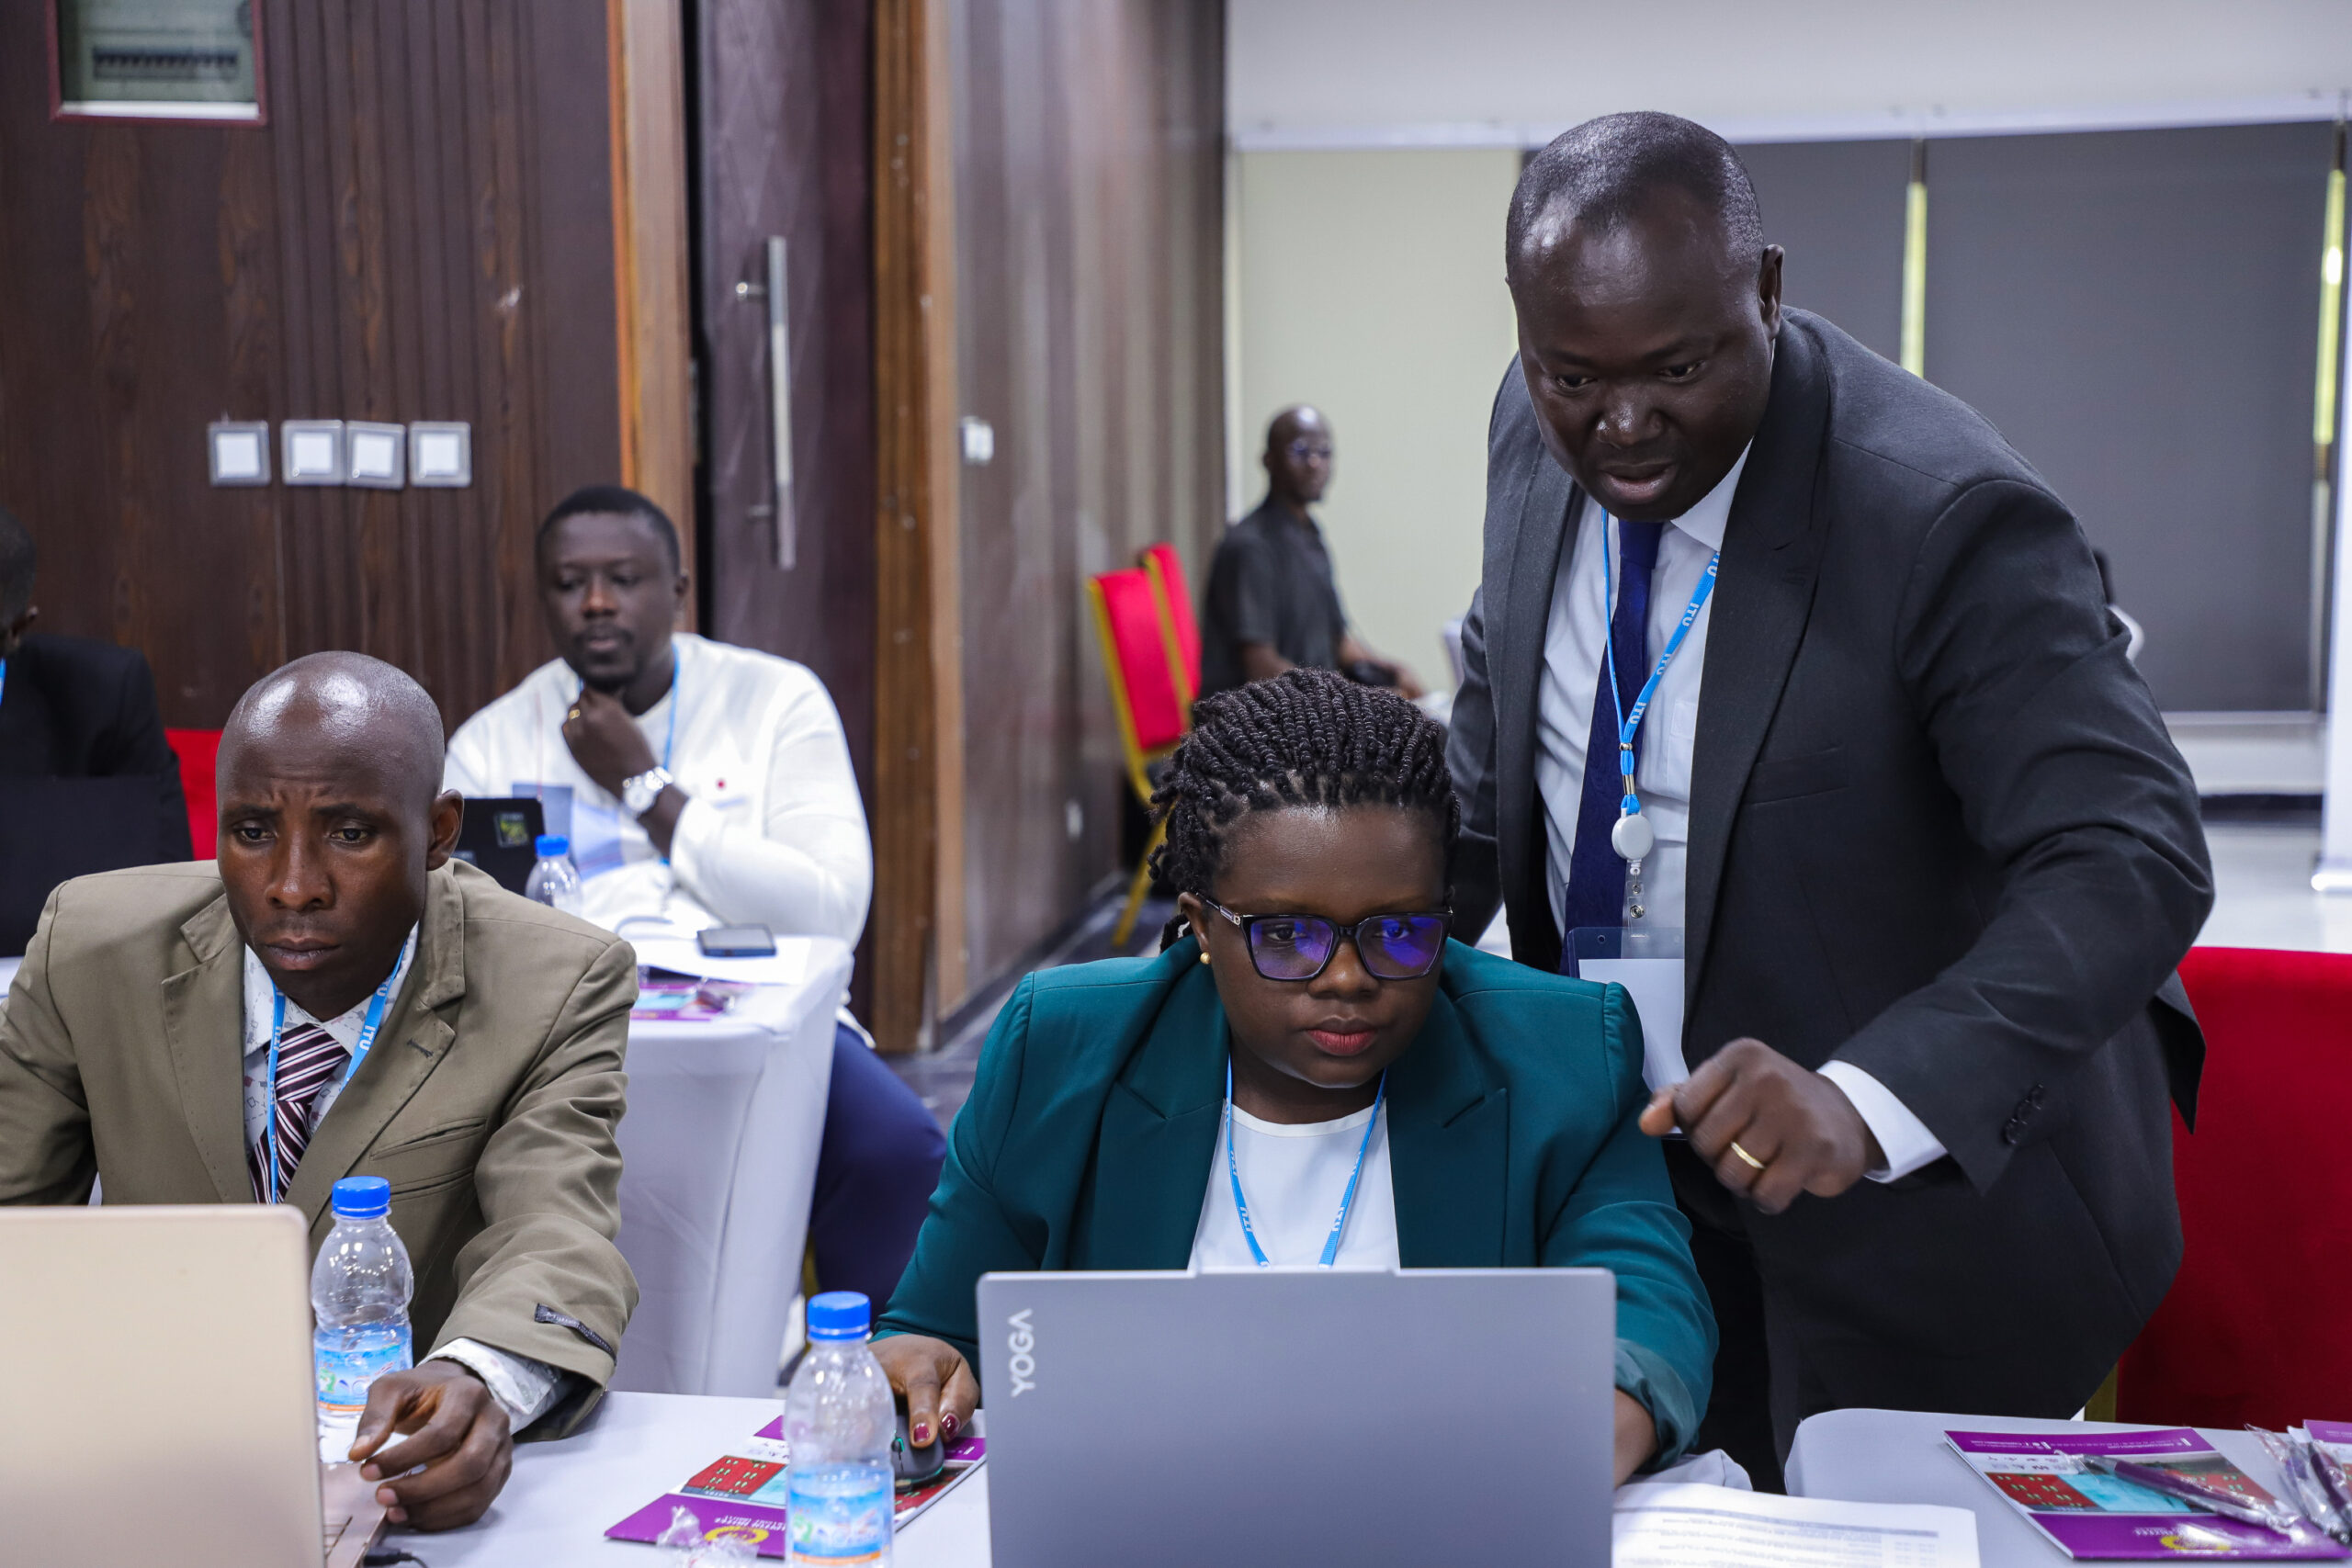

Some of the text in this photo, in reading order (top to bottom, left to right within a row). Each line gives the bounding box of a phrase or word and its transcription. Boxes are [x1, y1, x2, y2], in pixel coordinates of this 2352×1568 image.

[1682, 603, 1700, 626] ITU
[1657, 654, 1671, 675] ITU
[1629, 702, 1646, 724] ITU
[359, 1025, 376, 1051] ITU
[1008, 1307, 1035, 1397] YOGA
